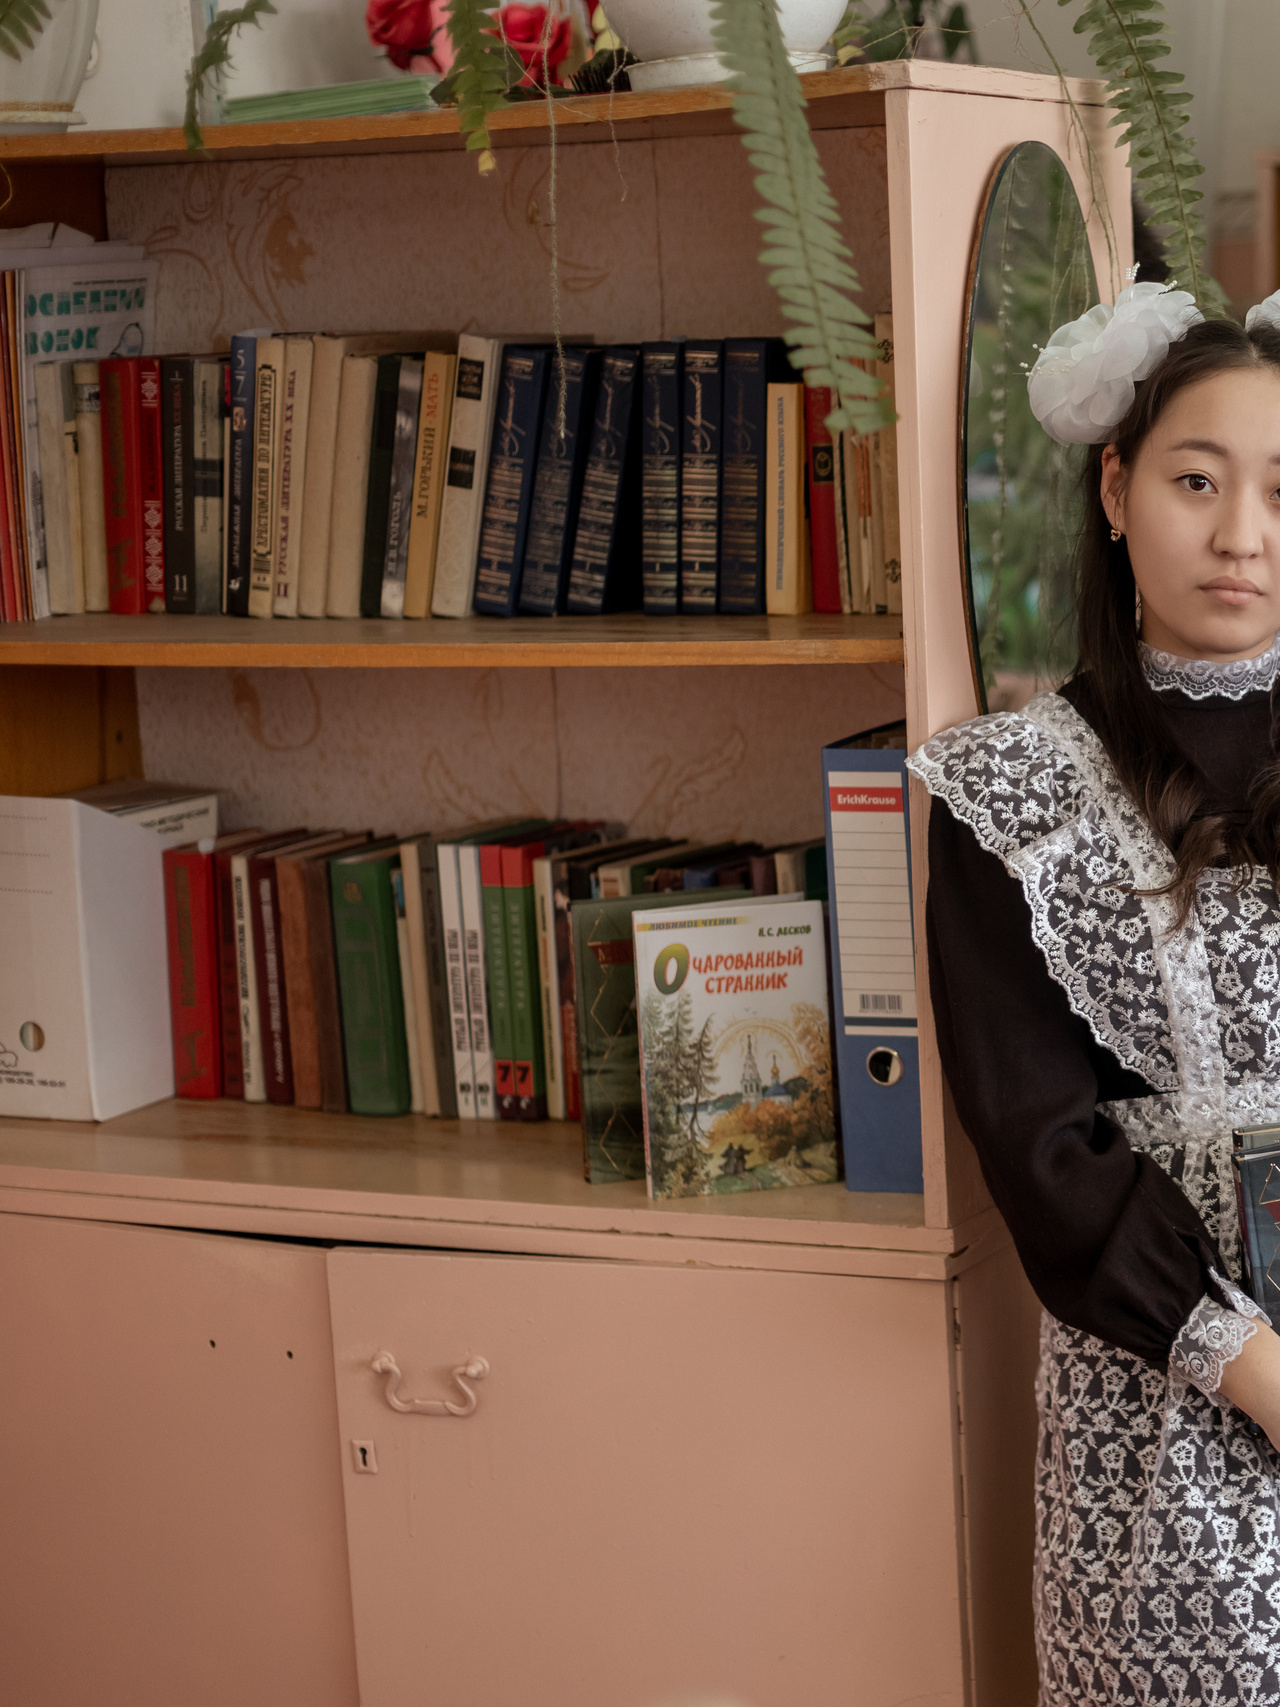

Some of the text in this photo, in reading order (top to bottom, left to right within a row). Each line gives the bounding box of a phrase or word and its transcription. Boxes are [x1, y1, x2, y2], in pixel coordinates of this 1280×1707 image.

[24, 286, 146, 318] ОСЛЕДНИЙ
[24, 326, 100, 355] ВОНОК
[425, 373, 439, 418] МАТЬ
[173, 425, 183, 486] ЛИТЕРАТУРА
[257, 447, 270, 464] ПО
[417, 427, 436, 500] ГОРЬКИЙ
[277, 370, 296, 576] РУССКАЯ ЛИТЕРАТУРА XX ВЕКА
[389, 491, 401, 546] ГОГОЛЬ
[837, 794, 896, 805] ErichKrause
[648, 917, 738, 931] ЛЮБИМОЕ ЧТЕНИЕ
[776, 925, 812, 937] ЛЕСКОВ
[705, 972, 789, 994] СТРАННИК
[498, 1065, 511, 1082] 7
[517, 1066, 530, 1084] 7
